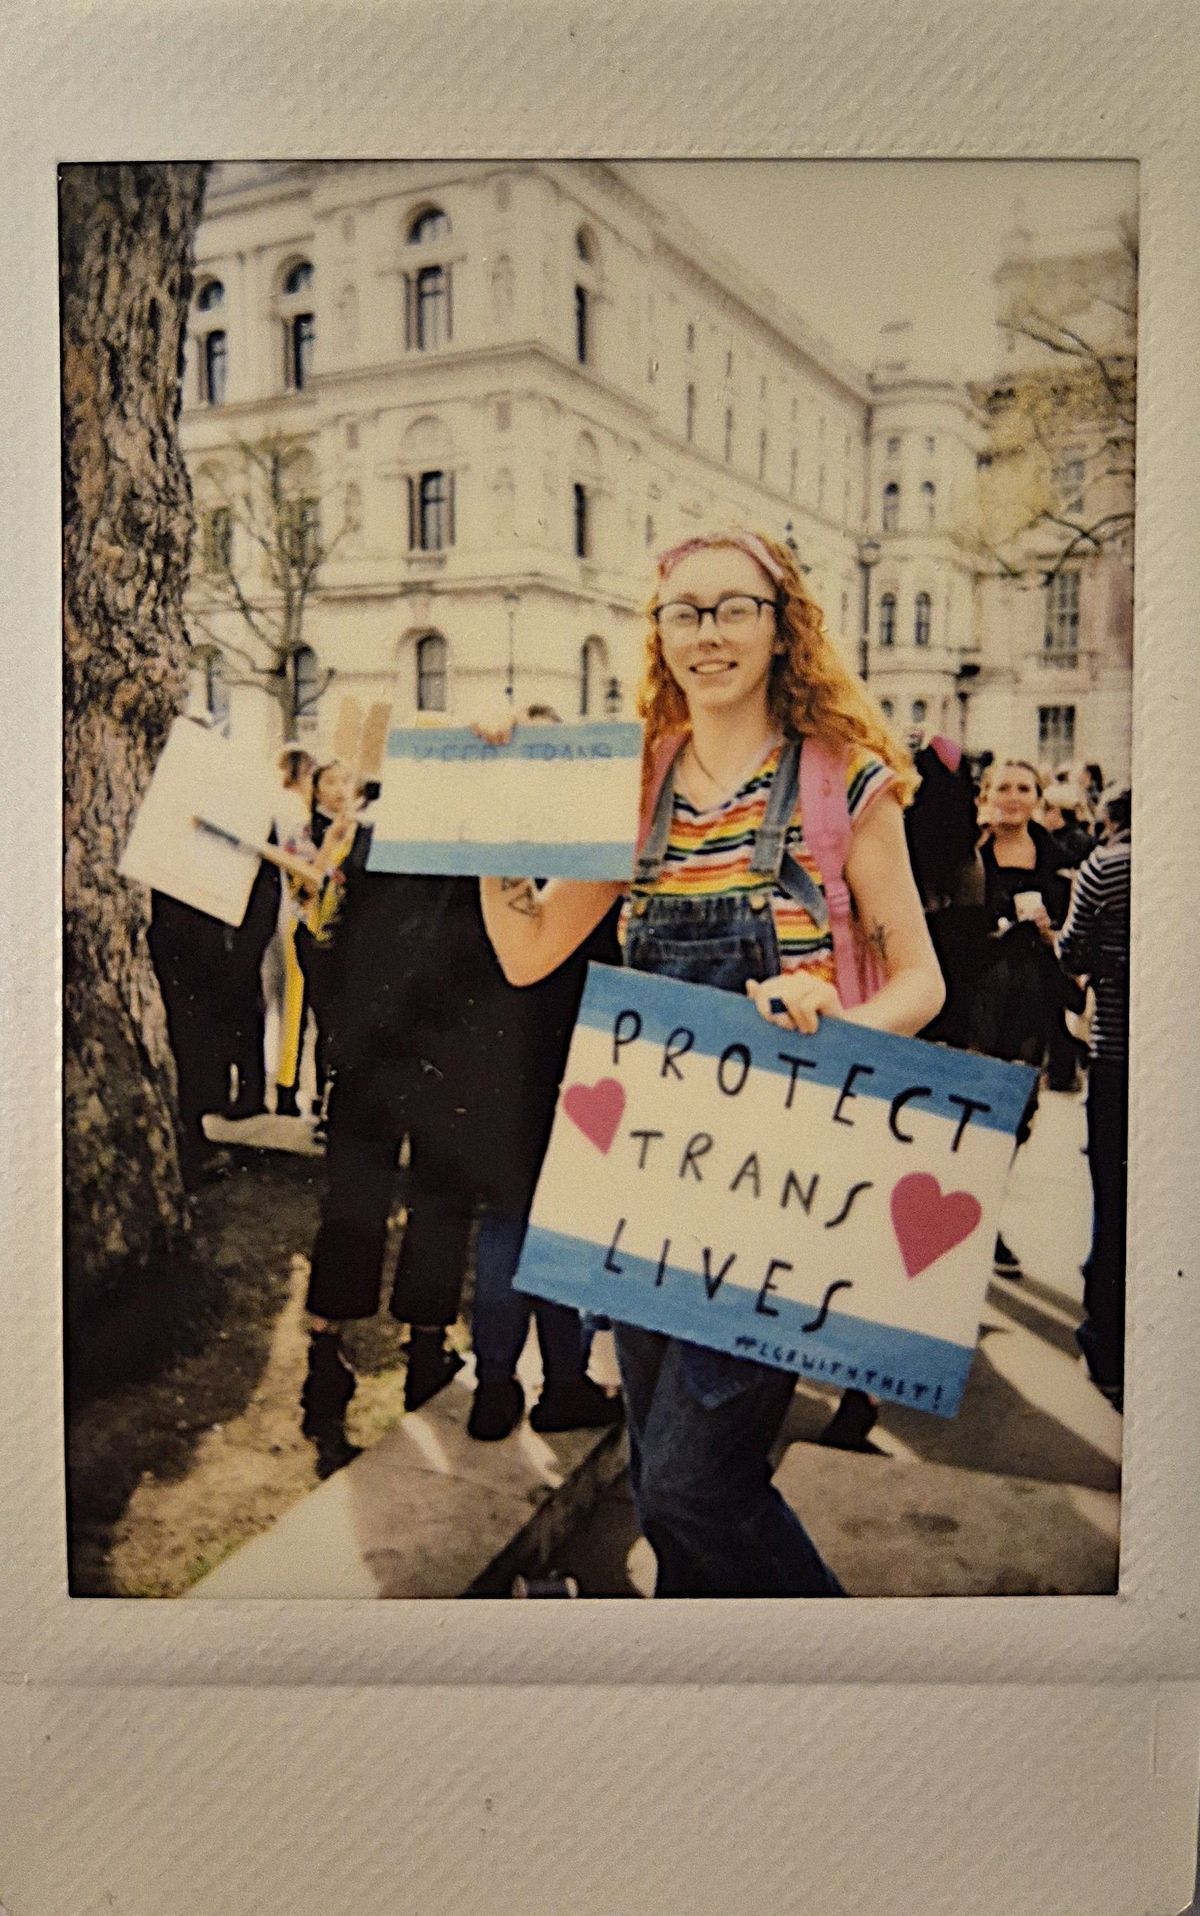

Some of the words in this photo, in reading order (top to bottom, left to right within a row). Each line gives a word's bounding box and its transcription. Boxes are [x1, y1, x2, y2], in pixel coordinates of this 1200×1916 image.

[611, 1009, 992, 1153] PROTECT
[629, 1130, 874, 1229] TRANS
[603, 1217, 853, 1333] LIVES
